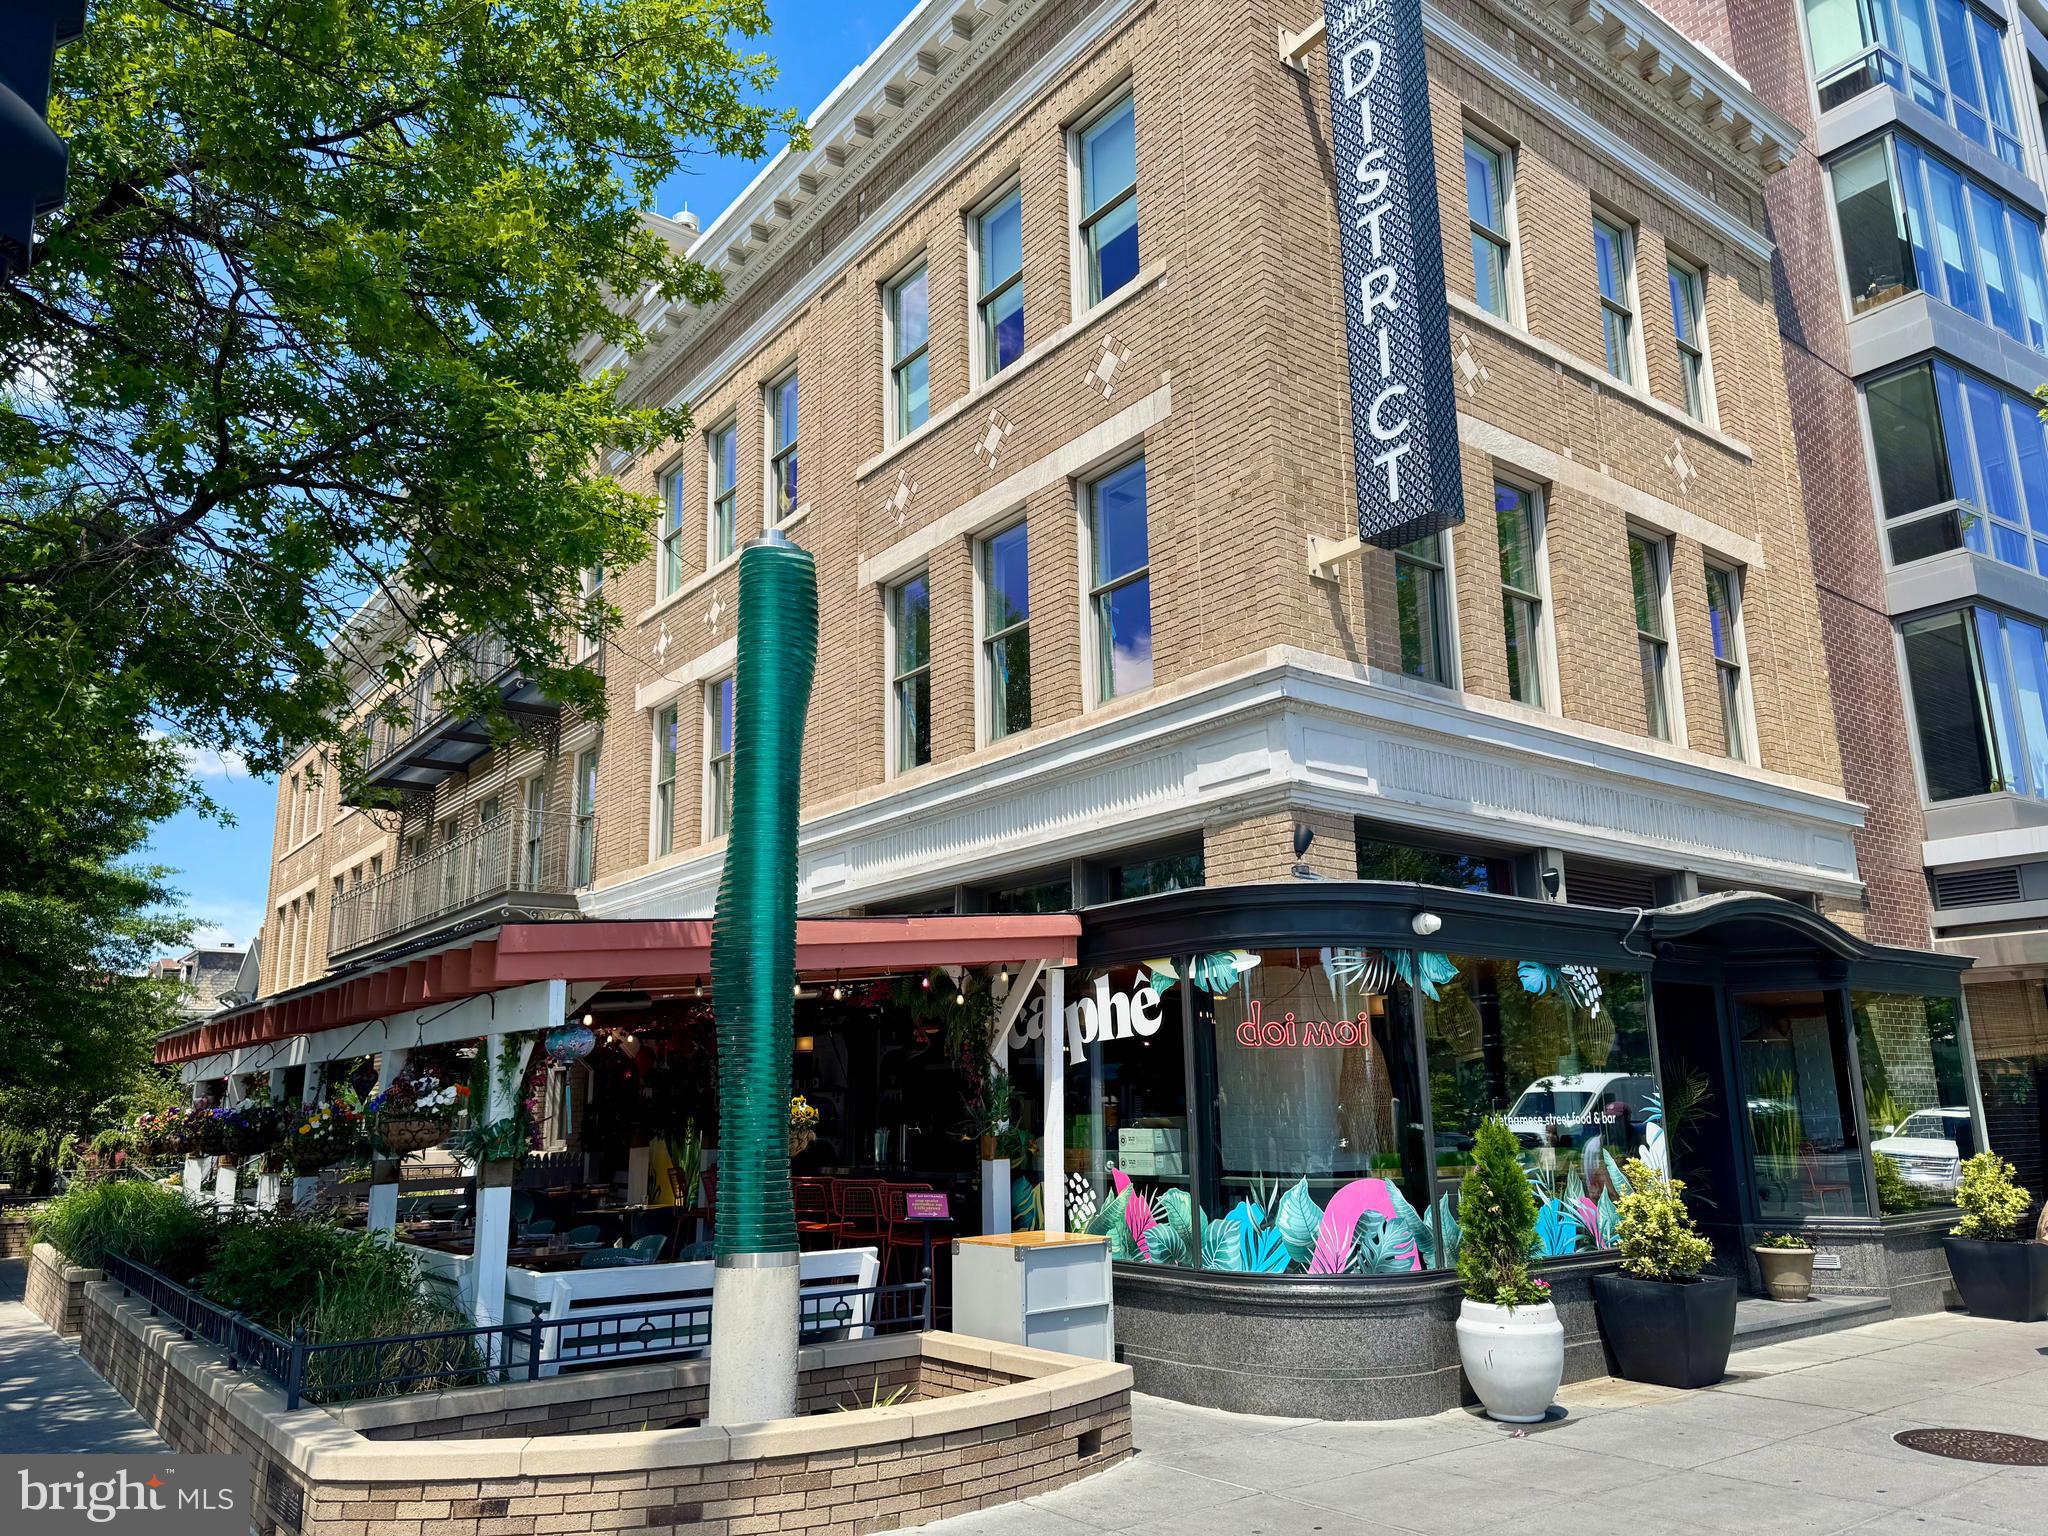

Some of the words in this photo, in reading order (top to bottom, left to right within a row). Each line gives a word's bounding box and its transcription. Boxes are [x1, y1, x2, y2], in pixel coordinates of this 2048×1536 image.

[1342, 39, 1411, 503] DISTRICT
[1236, 1000, 1297, 1047] doi
[1303, 1011, 1369, 1047] moi
[1545, 1112, 1570, 1126] street
[1571, 1111, 1592, 1125] food
[1593, 1111, 1600, 1124] &
[1601, 1110, 1616, 1124] bar
